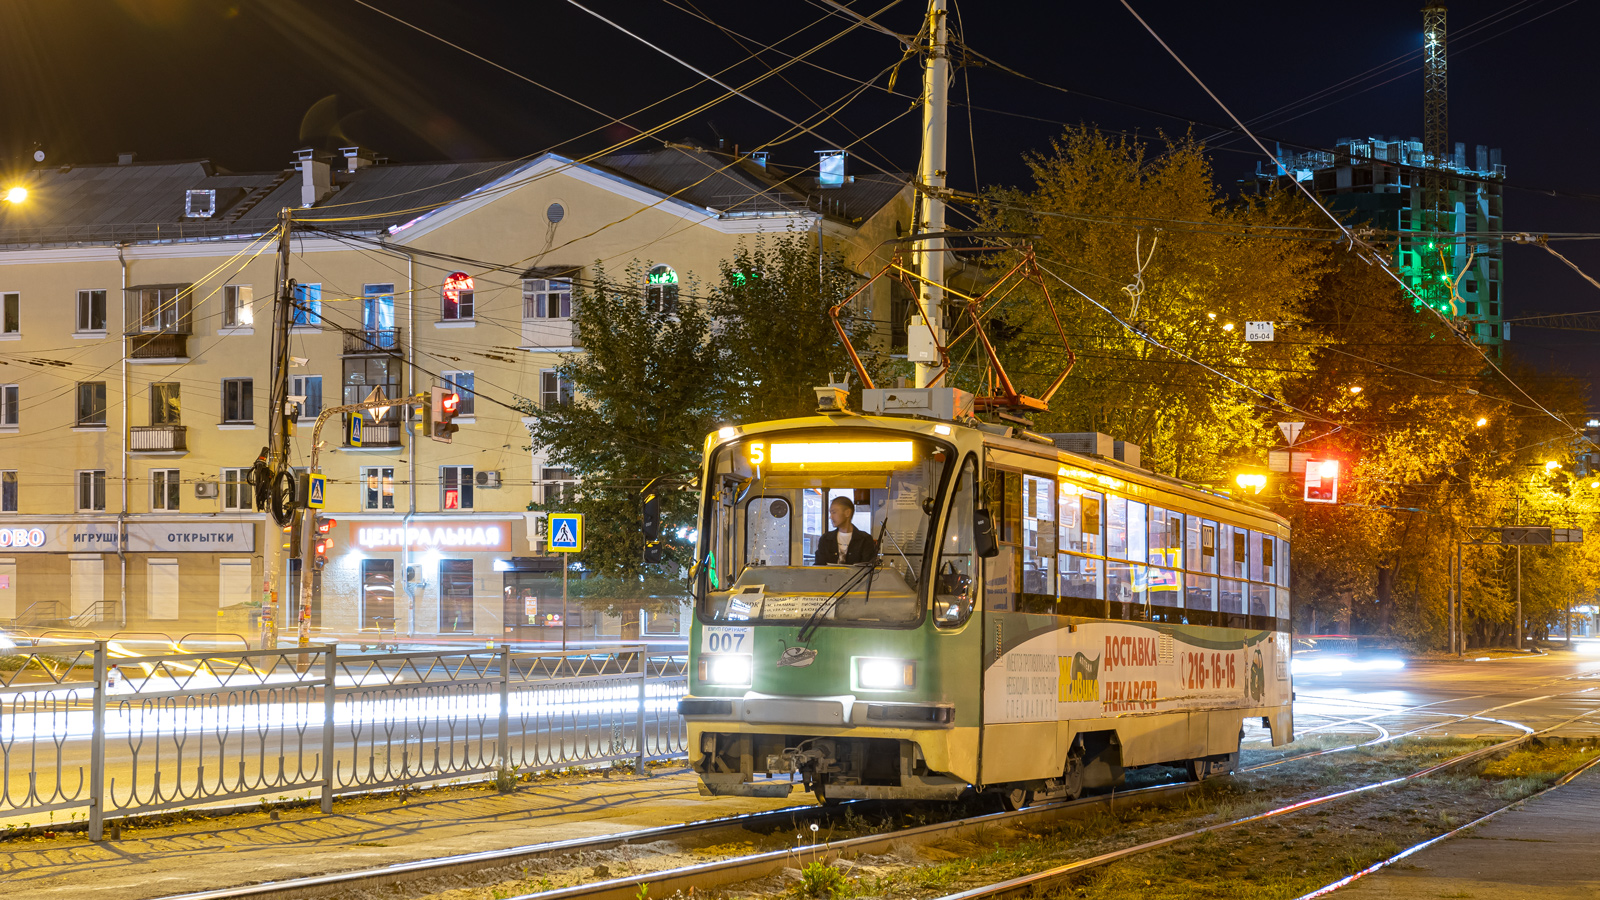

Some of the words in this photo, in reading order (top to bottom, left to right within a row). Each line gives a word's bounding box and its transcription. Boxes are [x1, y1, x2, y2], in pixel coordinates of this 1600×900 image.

[750, 443, 764, 464] 5
[73, 533, 129, 543] ИГРУШКИ
[167, 533, 234, 543] ОТКРЫТКИ
[359, 526, 500, 548] ЦЕНТРАЛЬНАЯ
[709, 632, 745, 652] 007
[1104, 635, 1158, 672] ДОСТАВКА
[1104, 680, 1158, 712] ЛЕКАРСТВ
